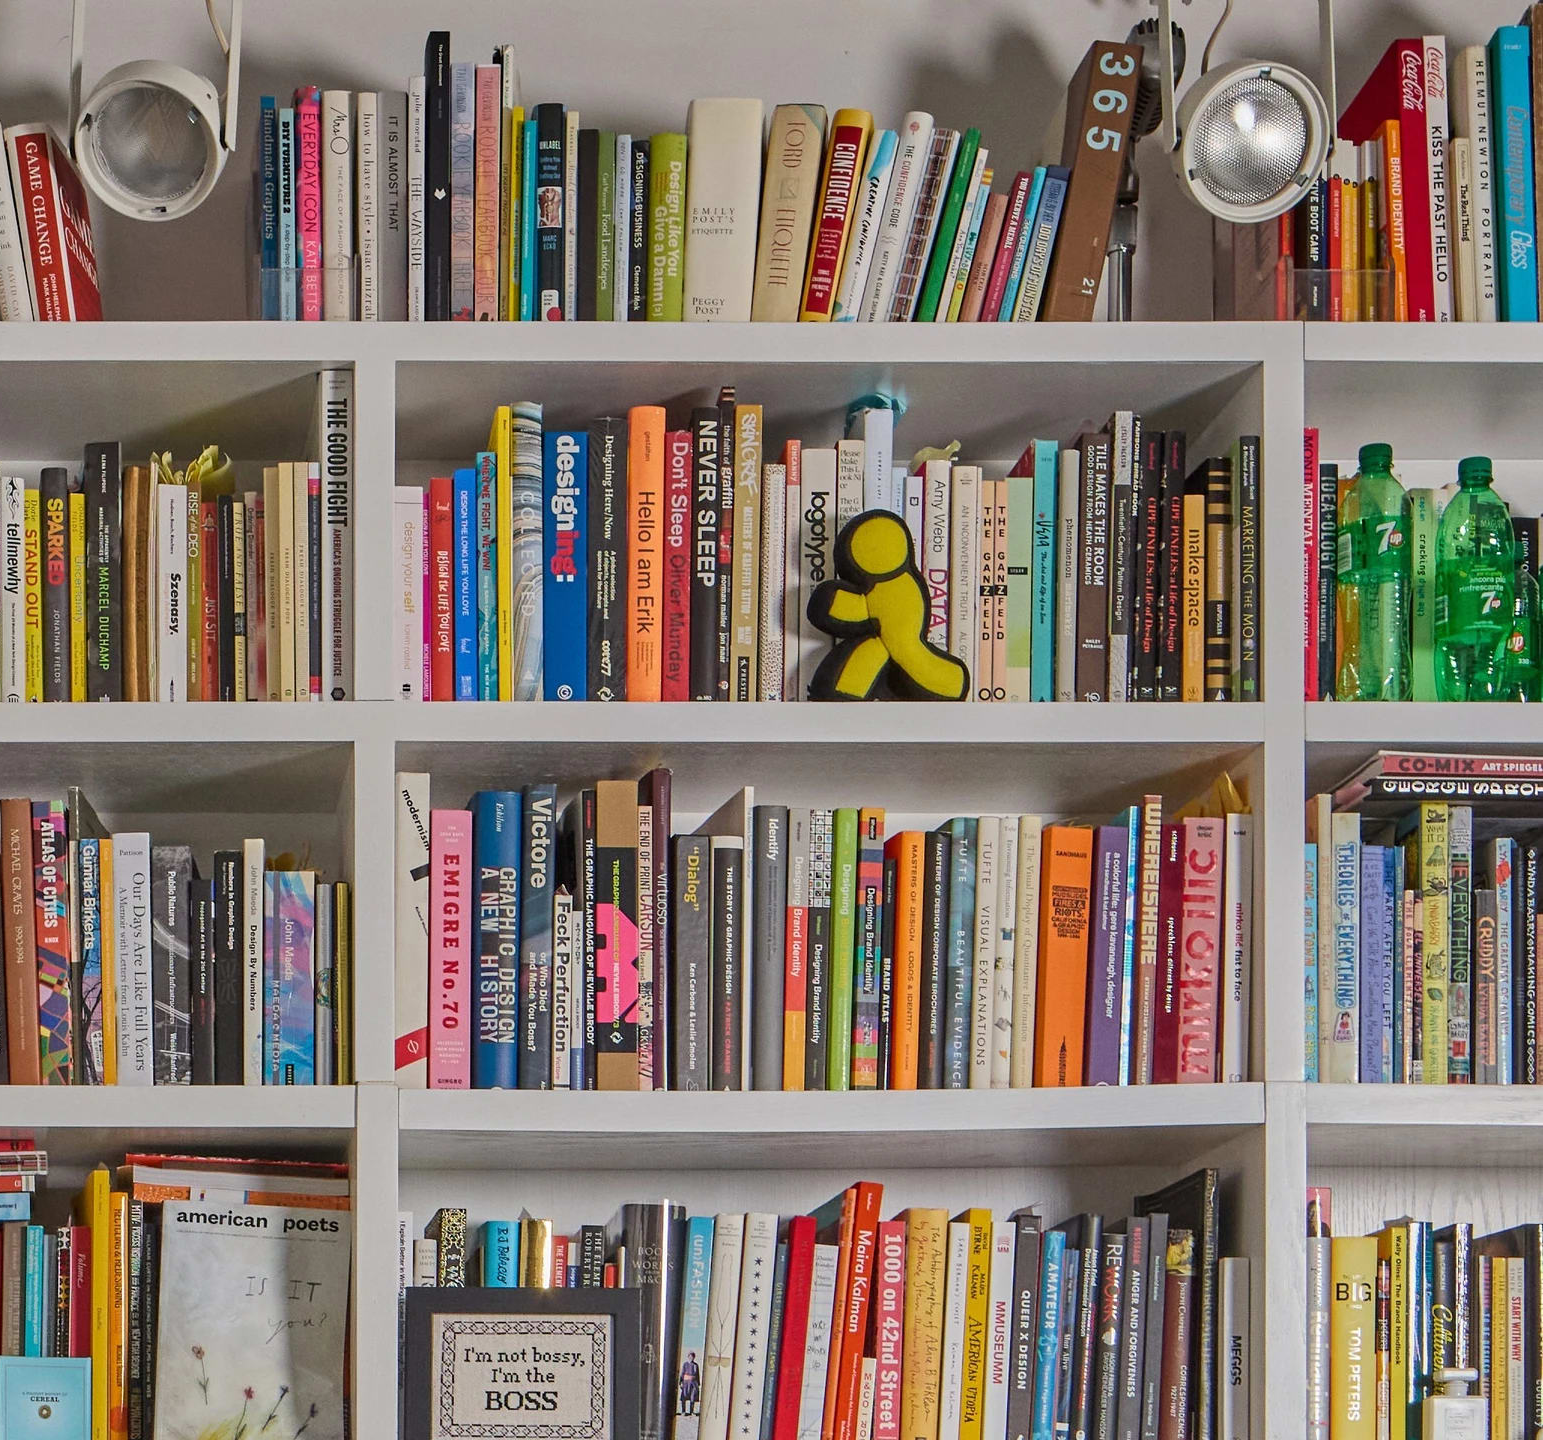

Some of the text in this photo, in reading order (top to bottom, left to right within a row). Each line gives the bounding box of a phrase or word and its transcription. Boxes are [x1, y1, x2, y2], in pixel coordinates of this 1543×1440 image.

[25, 141, 54, 266] GAME CHANGE
[822, 143, 856, 222] CONFIDENCE
[1431, 125, 1448, 282] KISS THE PAST HELLO
[326, 399, 348, 528] THE GOOD FIGHT
[551, 435, 580, 582] designing:
[697, 420, 718, 587] NEVER SLEEP
[4, 523, 21, 595] tellmewhy
[47, 498, 65, 586] SPARKED
[637, 491, 655, 542] Hello
[805, 491, 831, 582] logotype
[25, 529, 39, 629] STAND OUT
[97, 567, 110, 670] MARCEL DUCHAMP
[168, 573, 182, 636] Szenasy.
[637, 559, 652, 589] am
[637, 596, 655, 634] Erik
[1399, 757, 1475, 773] CO-MIX
[41, 822, 59, 929] ATLAS OF CITIES
[530, 798, 553, 888] Victore
[764, 818, 779, 860] Identify
[82, 845, 98, 950] Gunnar Birkerts
[442, 854, 460, 948] EMIGRE
[480, 868, 499, 1042] A NEW HISTORY
[497, 868, 516, 1043] GRAPHIC DESIGN
[554, 902, 571, 1052] Feck Perfuction
[976, 842, 992, 1066] TUFTE VISUAL EXPLANATIONS
[176, 1211, 340, 1234] american poets
[848, 1230, 873, 1333] Maira Kalman
[463, 1347, 586, 1367] I'm not bossy,
[491, 1368, 555, 1384] I'm the
[879, 1234, 902, 1430] 1000 on 42nd Street
[992, 1302, 1007, 1384] MMUSEUMM
[1230, 1335, 1243, 1387] MEGGS
[1347, 1327, 1362, 1421] TOM PETERS
[484, 1391, 559, 1411] BOSS
